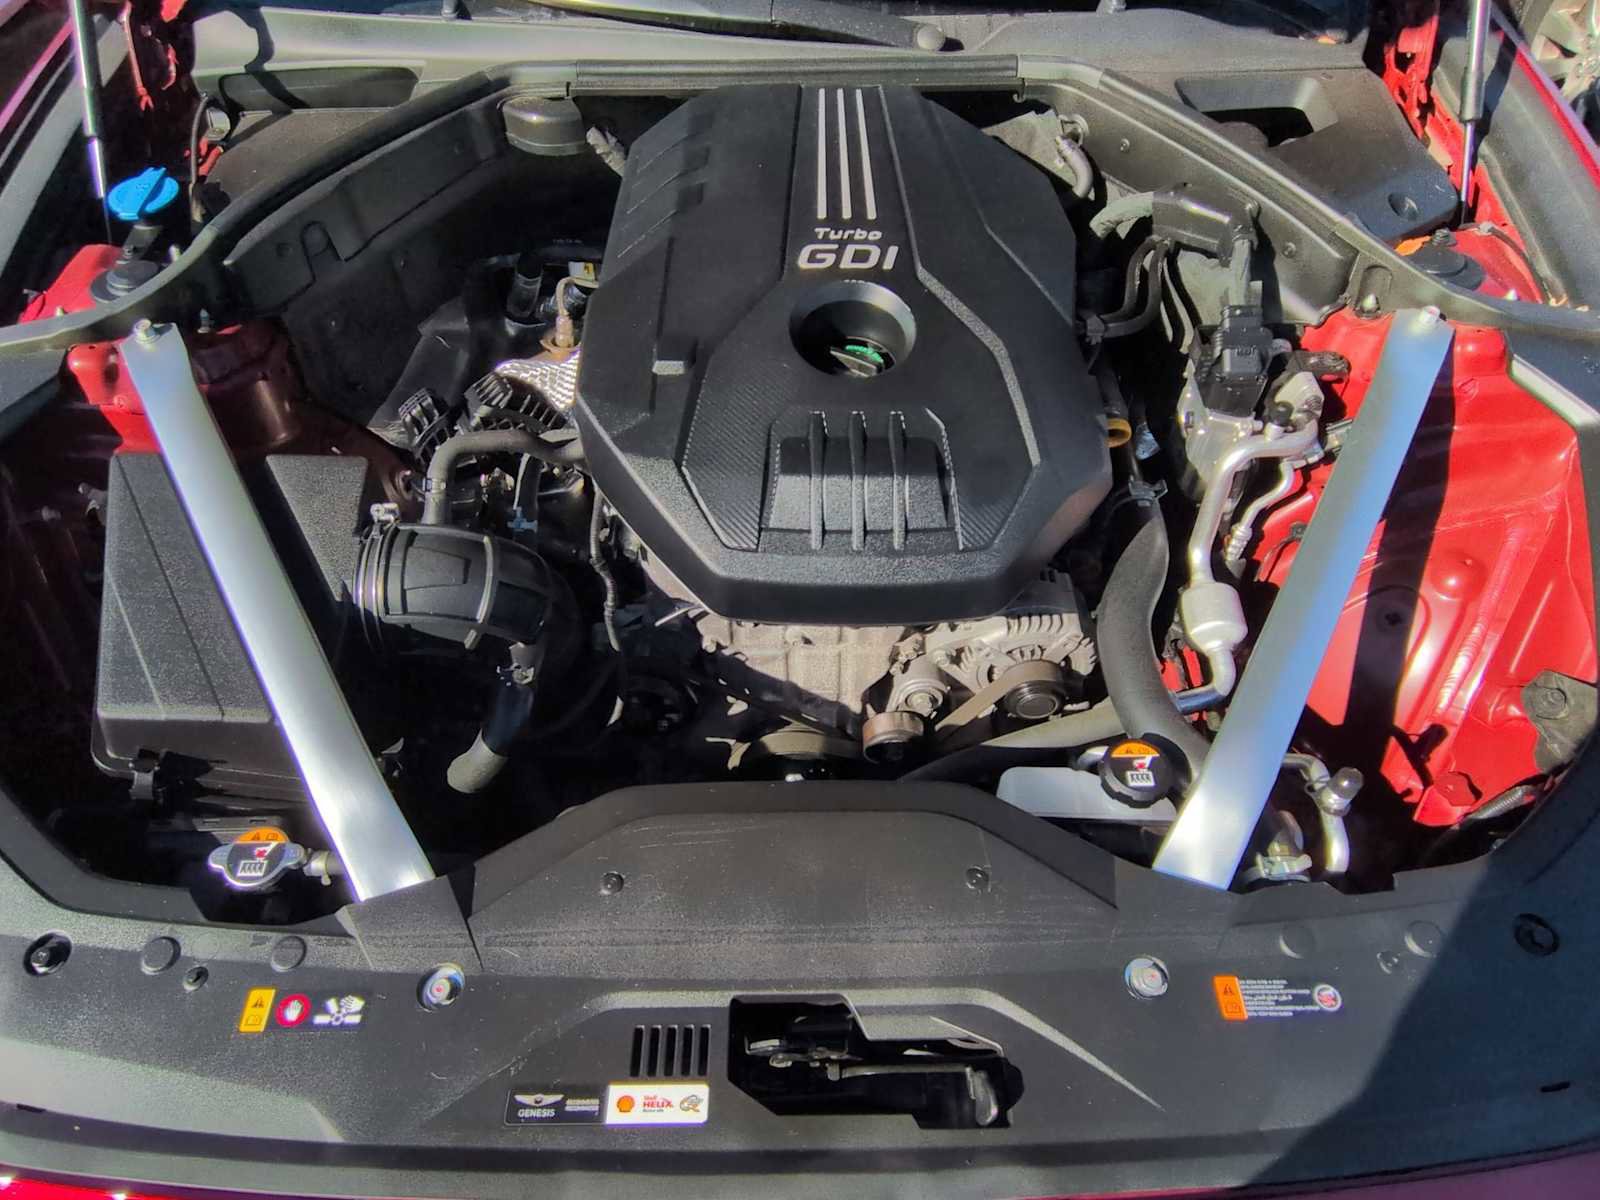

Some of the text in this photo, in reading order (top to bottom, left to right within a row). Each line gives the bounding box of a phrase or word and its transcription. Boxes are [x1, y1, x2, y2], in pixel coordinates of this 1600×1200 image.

[814, 228, 882, 240] Turbo
[798, 243, 899, 270] GDI
[643, 1100, 673, 1108] HELIX
[517, 1109, 555, 1117] GENESIS
